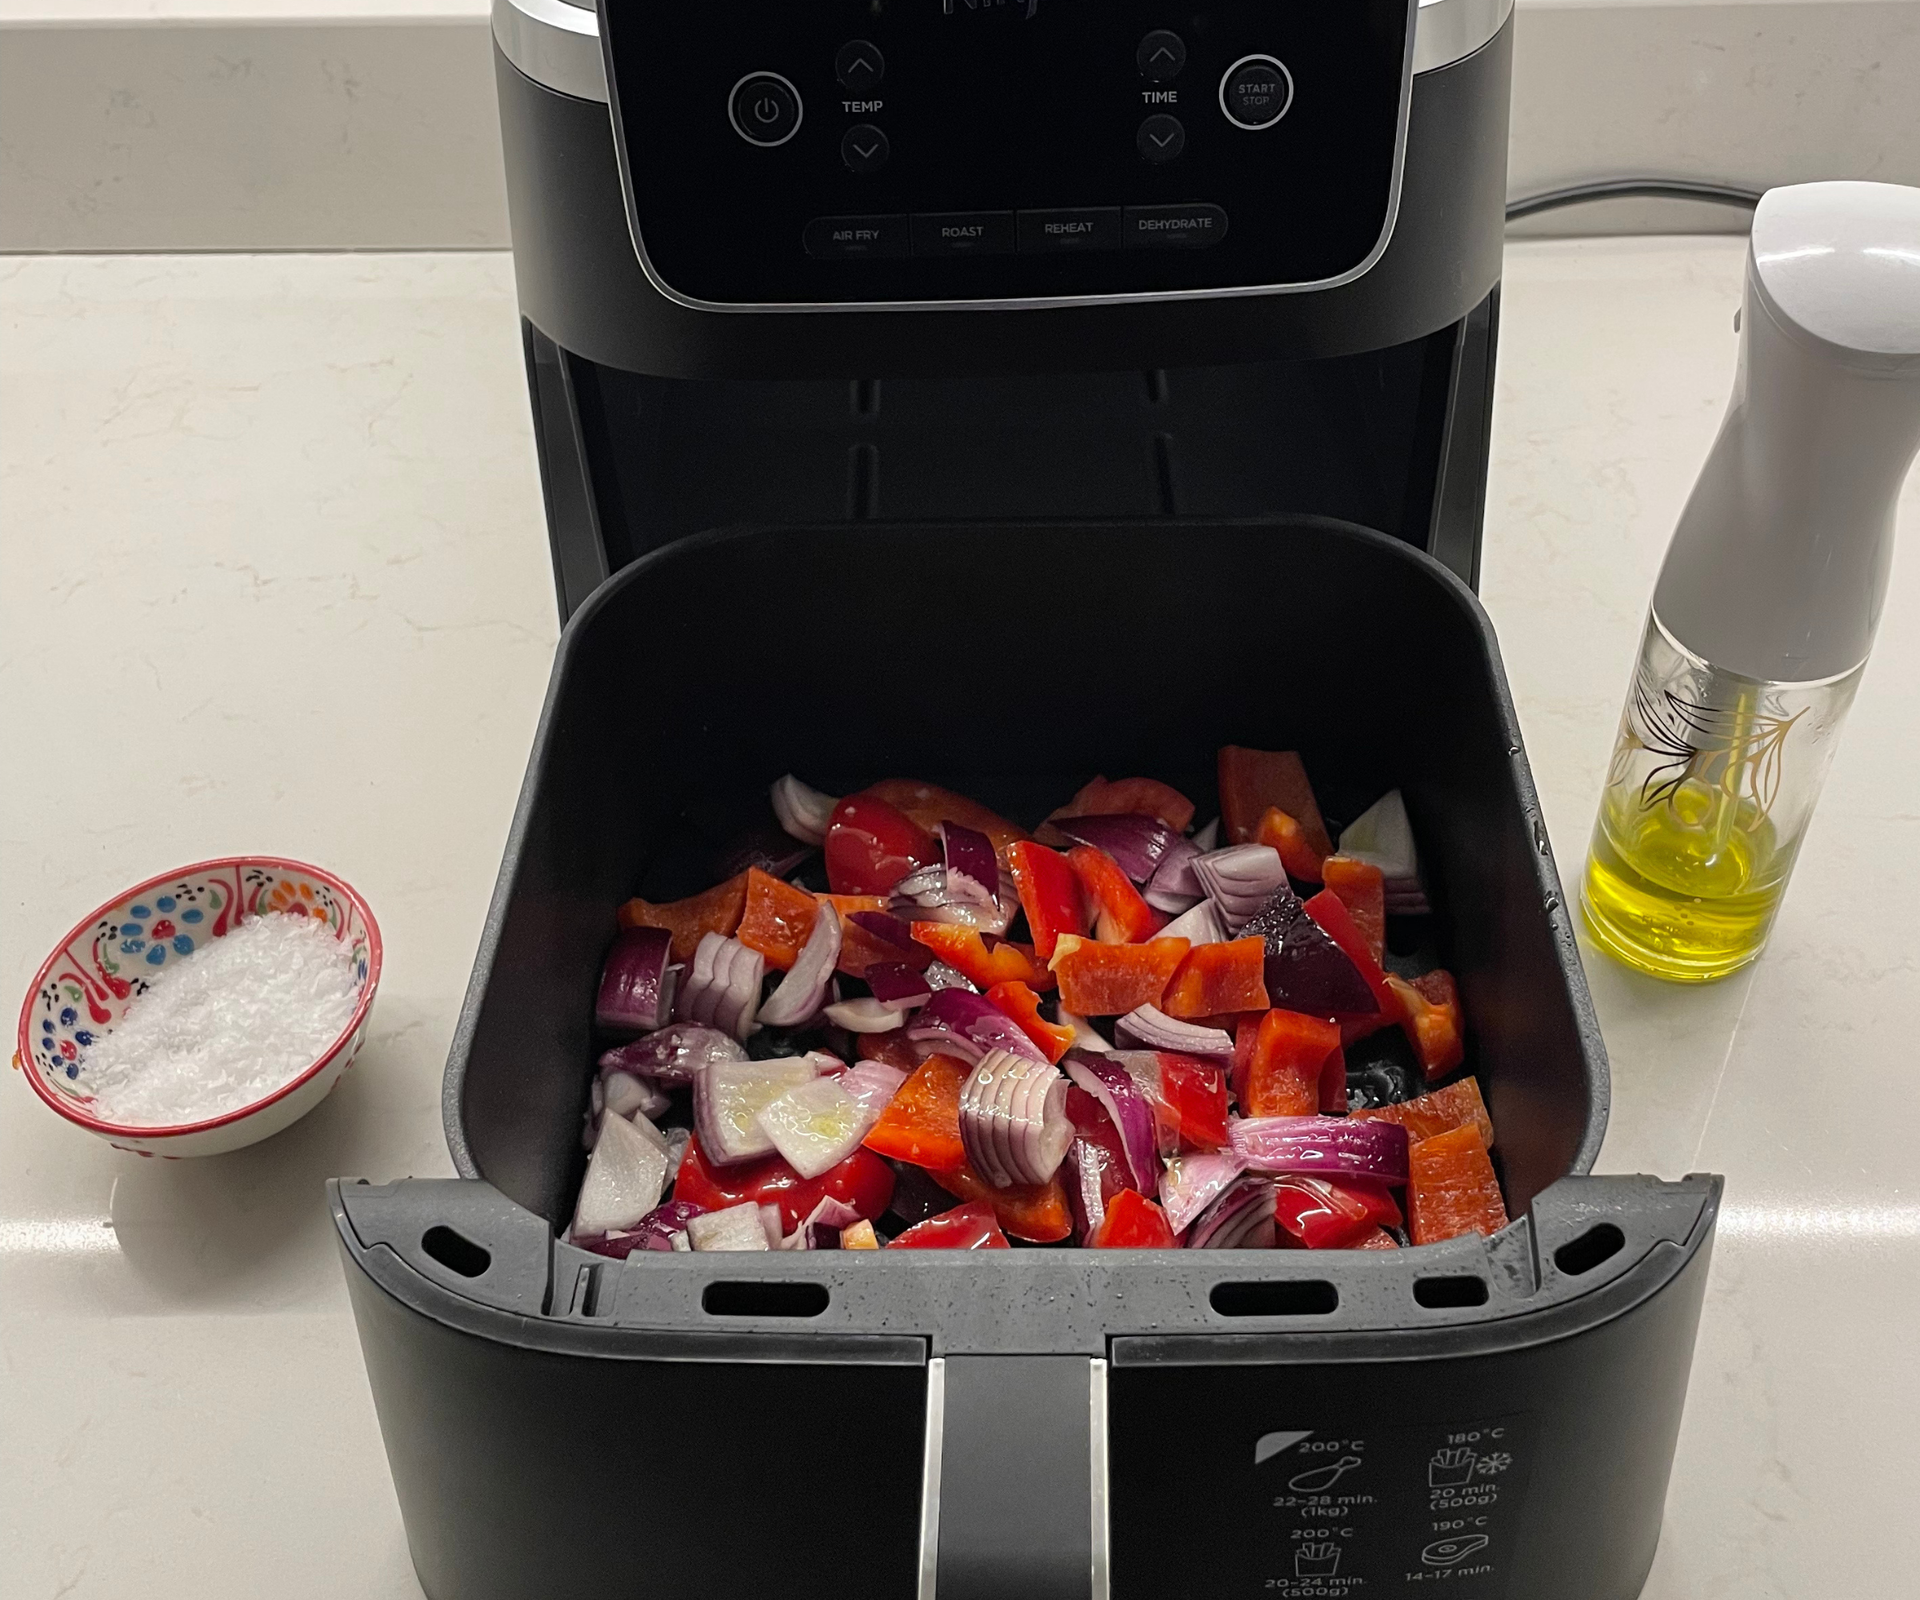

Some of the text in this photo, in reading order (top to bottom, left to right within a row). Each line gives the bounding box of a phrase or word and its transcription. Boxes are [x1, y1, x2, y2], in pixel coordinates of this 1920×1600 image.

[1237, 82, 1276, 95] START
[1141, 90, 1178, 104] TIME
[1242, 95, 1271, 107] STOP
[841, 100, 884, 113] TEMP
[1044, 221, 1094, 235] REHEAT
[1138, 217, 1213, 231] DEHYDRATE
[832, 229, 880, 242] AIR FRY
[941, 226, 984, 239] ROAST
[1447, 1427, 1505, 1445] 180°C
[1299, 1438, 1365, 1454] 200°C
[1429, 1483, 1501, 1500] 20 min.
[1337, 1493, 1378, 1505] min.
[1429, 1493, 1498, 1511] (500g)
[1300, 1506, 1349, 1518] (1kg)
[1431, 1516, 1488, 1532] 190°C
[1290, 1526, 1354, 1540] 200°C
[1457, 1564, 1495, 1578] min.
[1328, 1575, 1367, 1587] min.
[1281, 1587, 1349, 1599] (500g)
